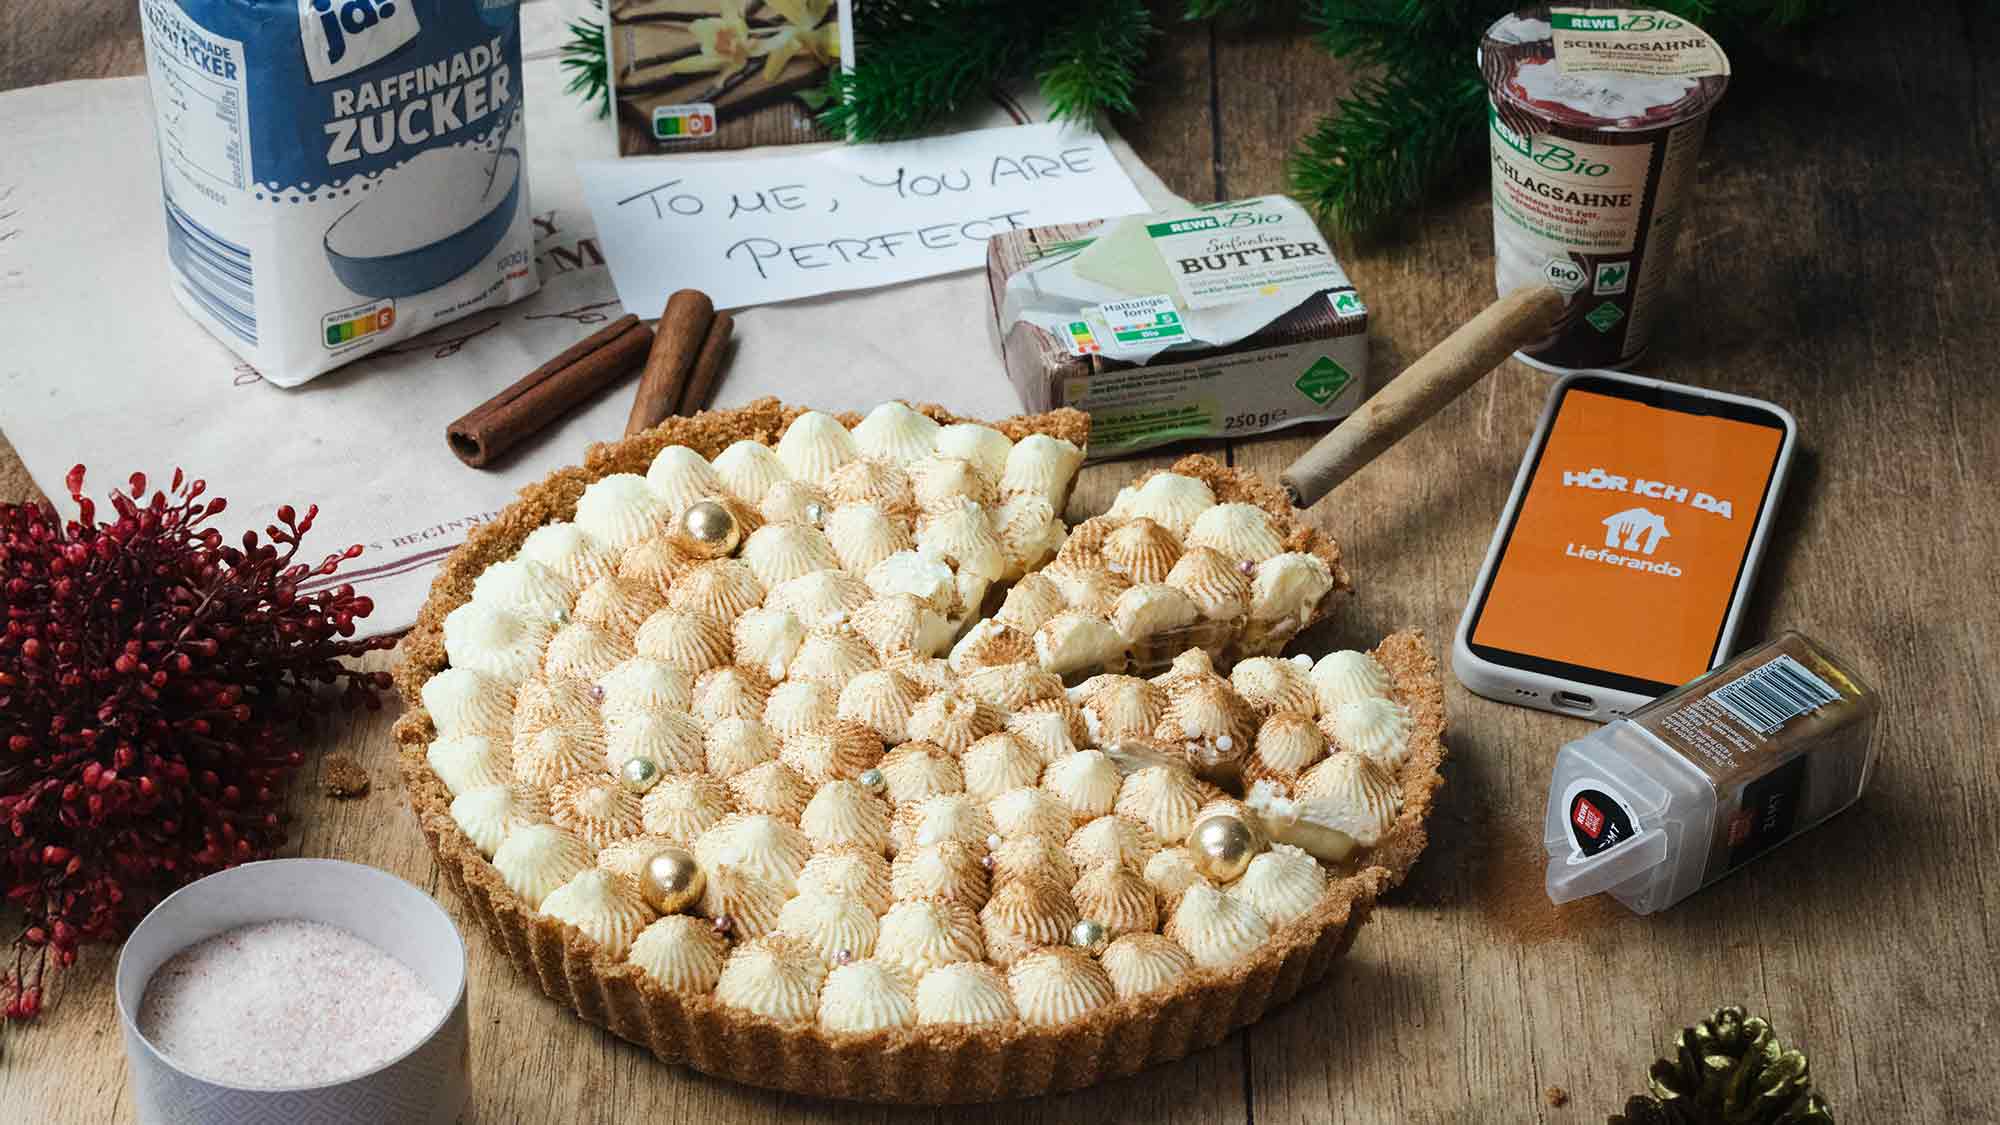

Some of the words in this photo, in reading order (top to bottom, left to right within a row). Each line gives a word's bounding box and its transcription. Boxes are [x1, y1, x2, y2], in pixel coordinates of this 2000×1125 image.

[313, 0, 396, 64] ja
[1571, 18, 1617, 29] REWE
[1621, 15, 1683, 32] Bio
[1563, 39, 1708, 51] SCHLAGSAHNE
[333, 35, 502, 118] RAFFINADE
[324, 64, 510, 165] ZUCKER
[1534, 142, 1611, 177] Bio
[617, 179, 704, 219] TO
[860, 167, 971, 200] YOU
[990, 147, 1098, 188] ARE
[1169, 218, 1217, 234] REWE
[1221, 212, 1283, 229] Bio
[725, 209, 1031, 280] PERFECT
[1177, 242, 1327, 274] BUTTER
[1103, 297, 1169, 312] Haltungs-
[1123, 307, 1158, 318] form
[1225, 413, 1256, 430] 250
[1562, 467, 1628, 492] HÖR
[1633, 478, 1689, 503] ICH
[1691, 492, 1734, 520] DA
[391, 511, 502, 548] BEGINNI
[1565, 542, 1683, 577] Lieferando
[1577, 802, 1590, 825] REWE
[1598, 822, 1620, 849] MT
